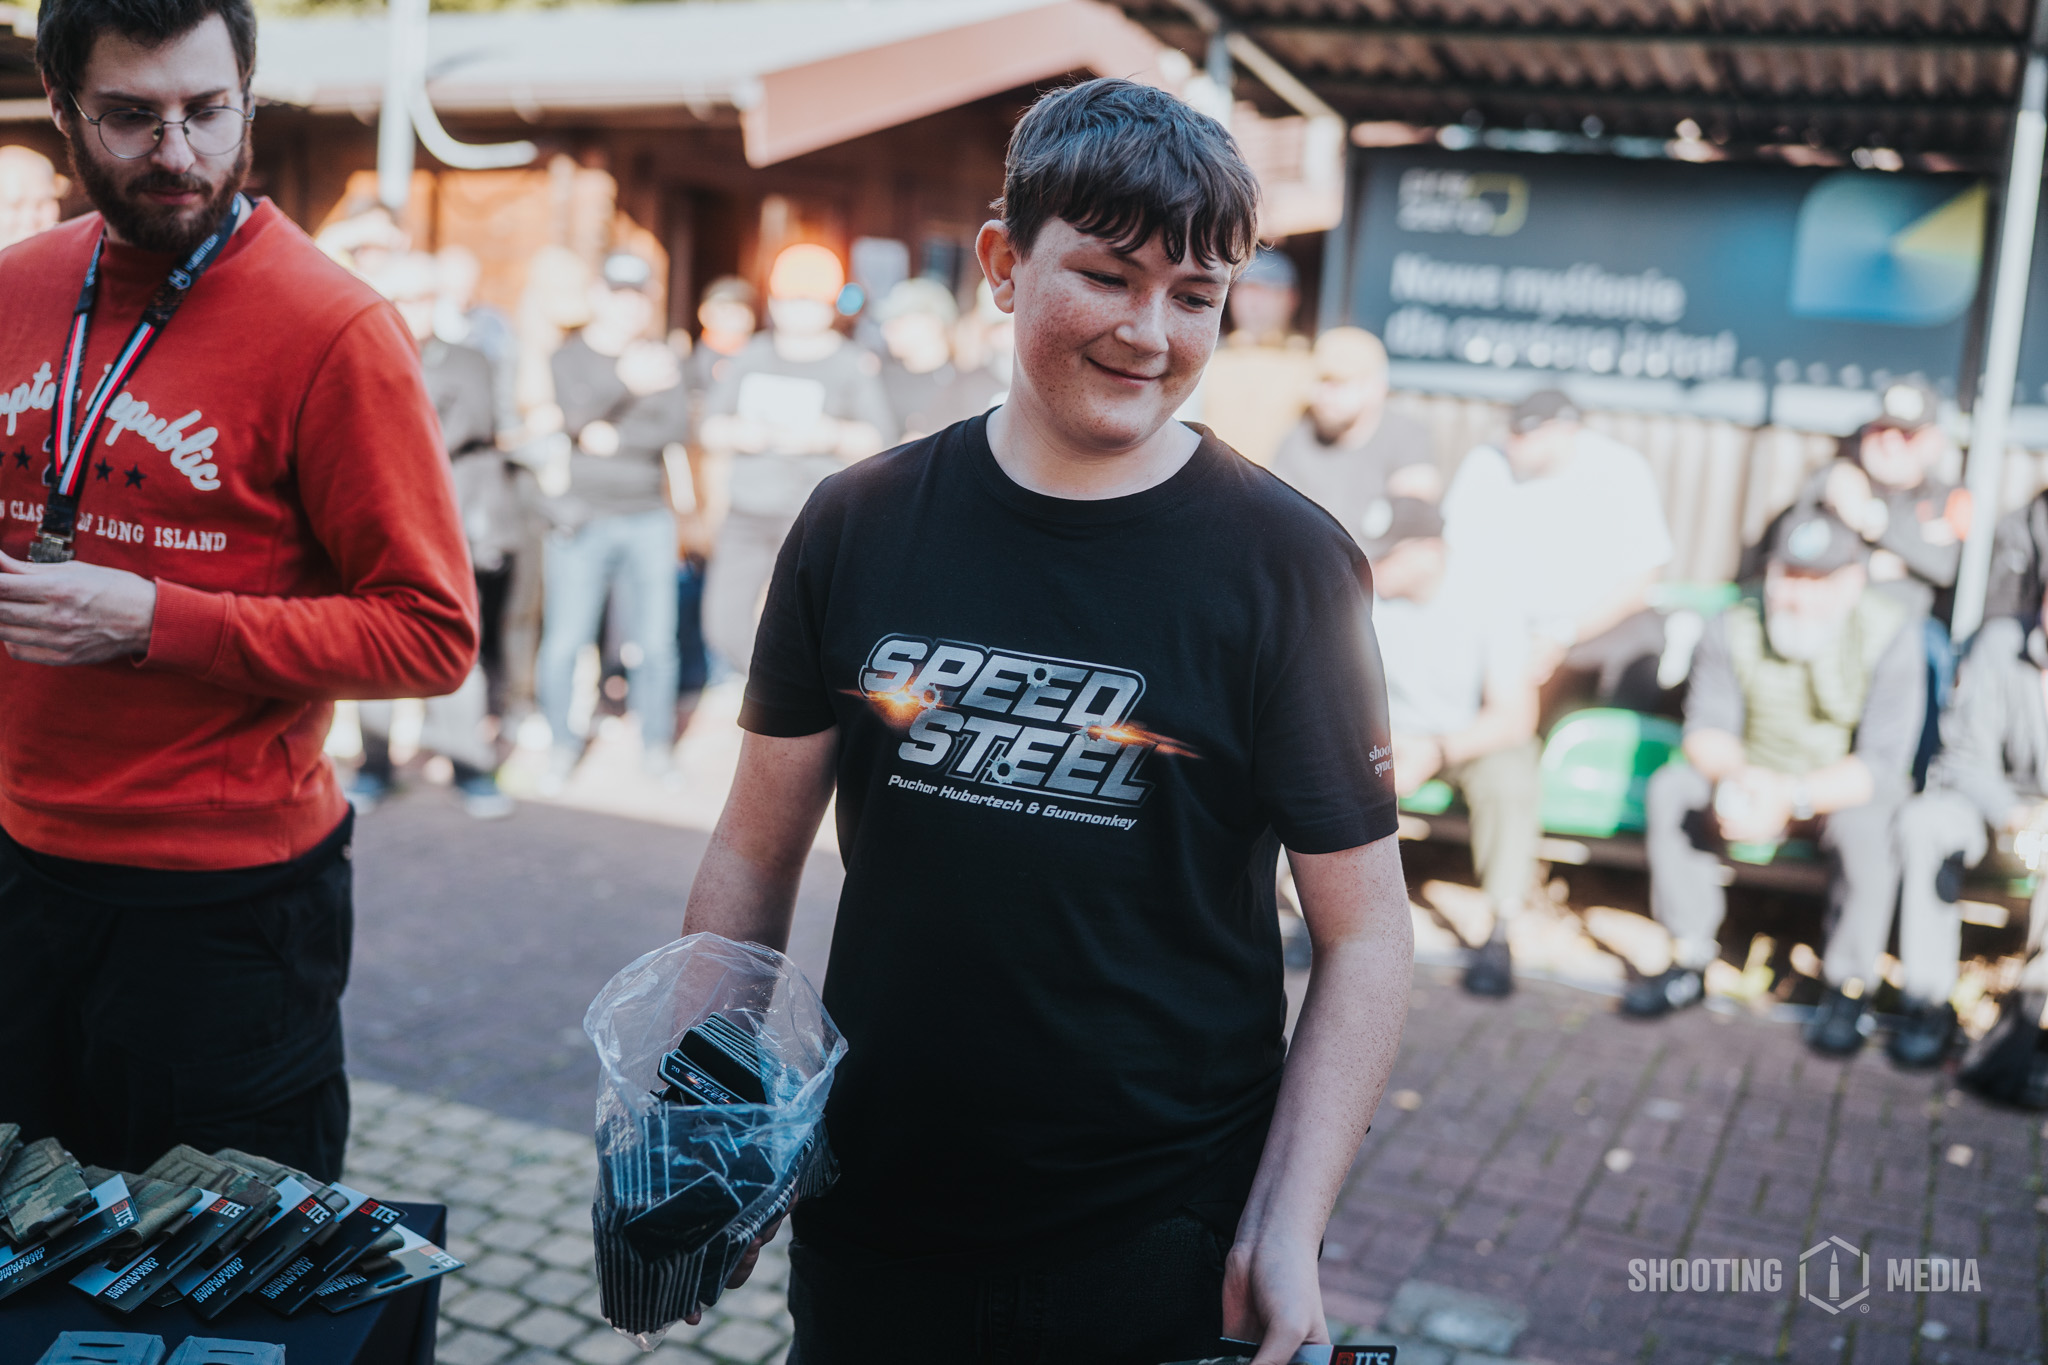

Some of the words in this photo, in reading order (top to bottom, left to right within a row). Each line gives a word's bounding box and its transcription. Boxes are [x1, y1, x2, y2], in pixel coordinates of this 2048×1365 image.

[10, 500, 45, 523] CLAS
[96, 515, 145, 543] LONG
[154, 526, 228, 551] ISLAND
[863, 640, 1139, 727] SPEED
[898, 709, 1151, 800] STEEL
[888, 774, 938, 796] Puchar
[939, 785, 1024, 812] Hubertech
[1026, 801, 1041, 815] &
[1042, 804, 1138, 830] Gunmonkey
[686, 1071, 730, 1099] SPEED
